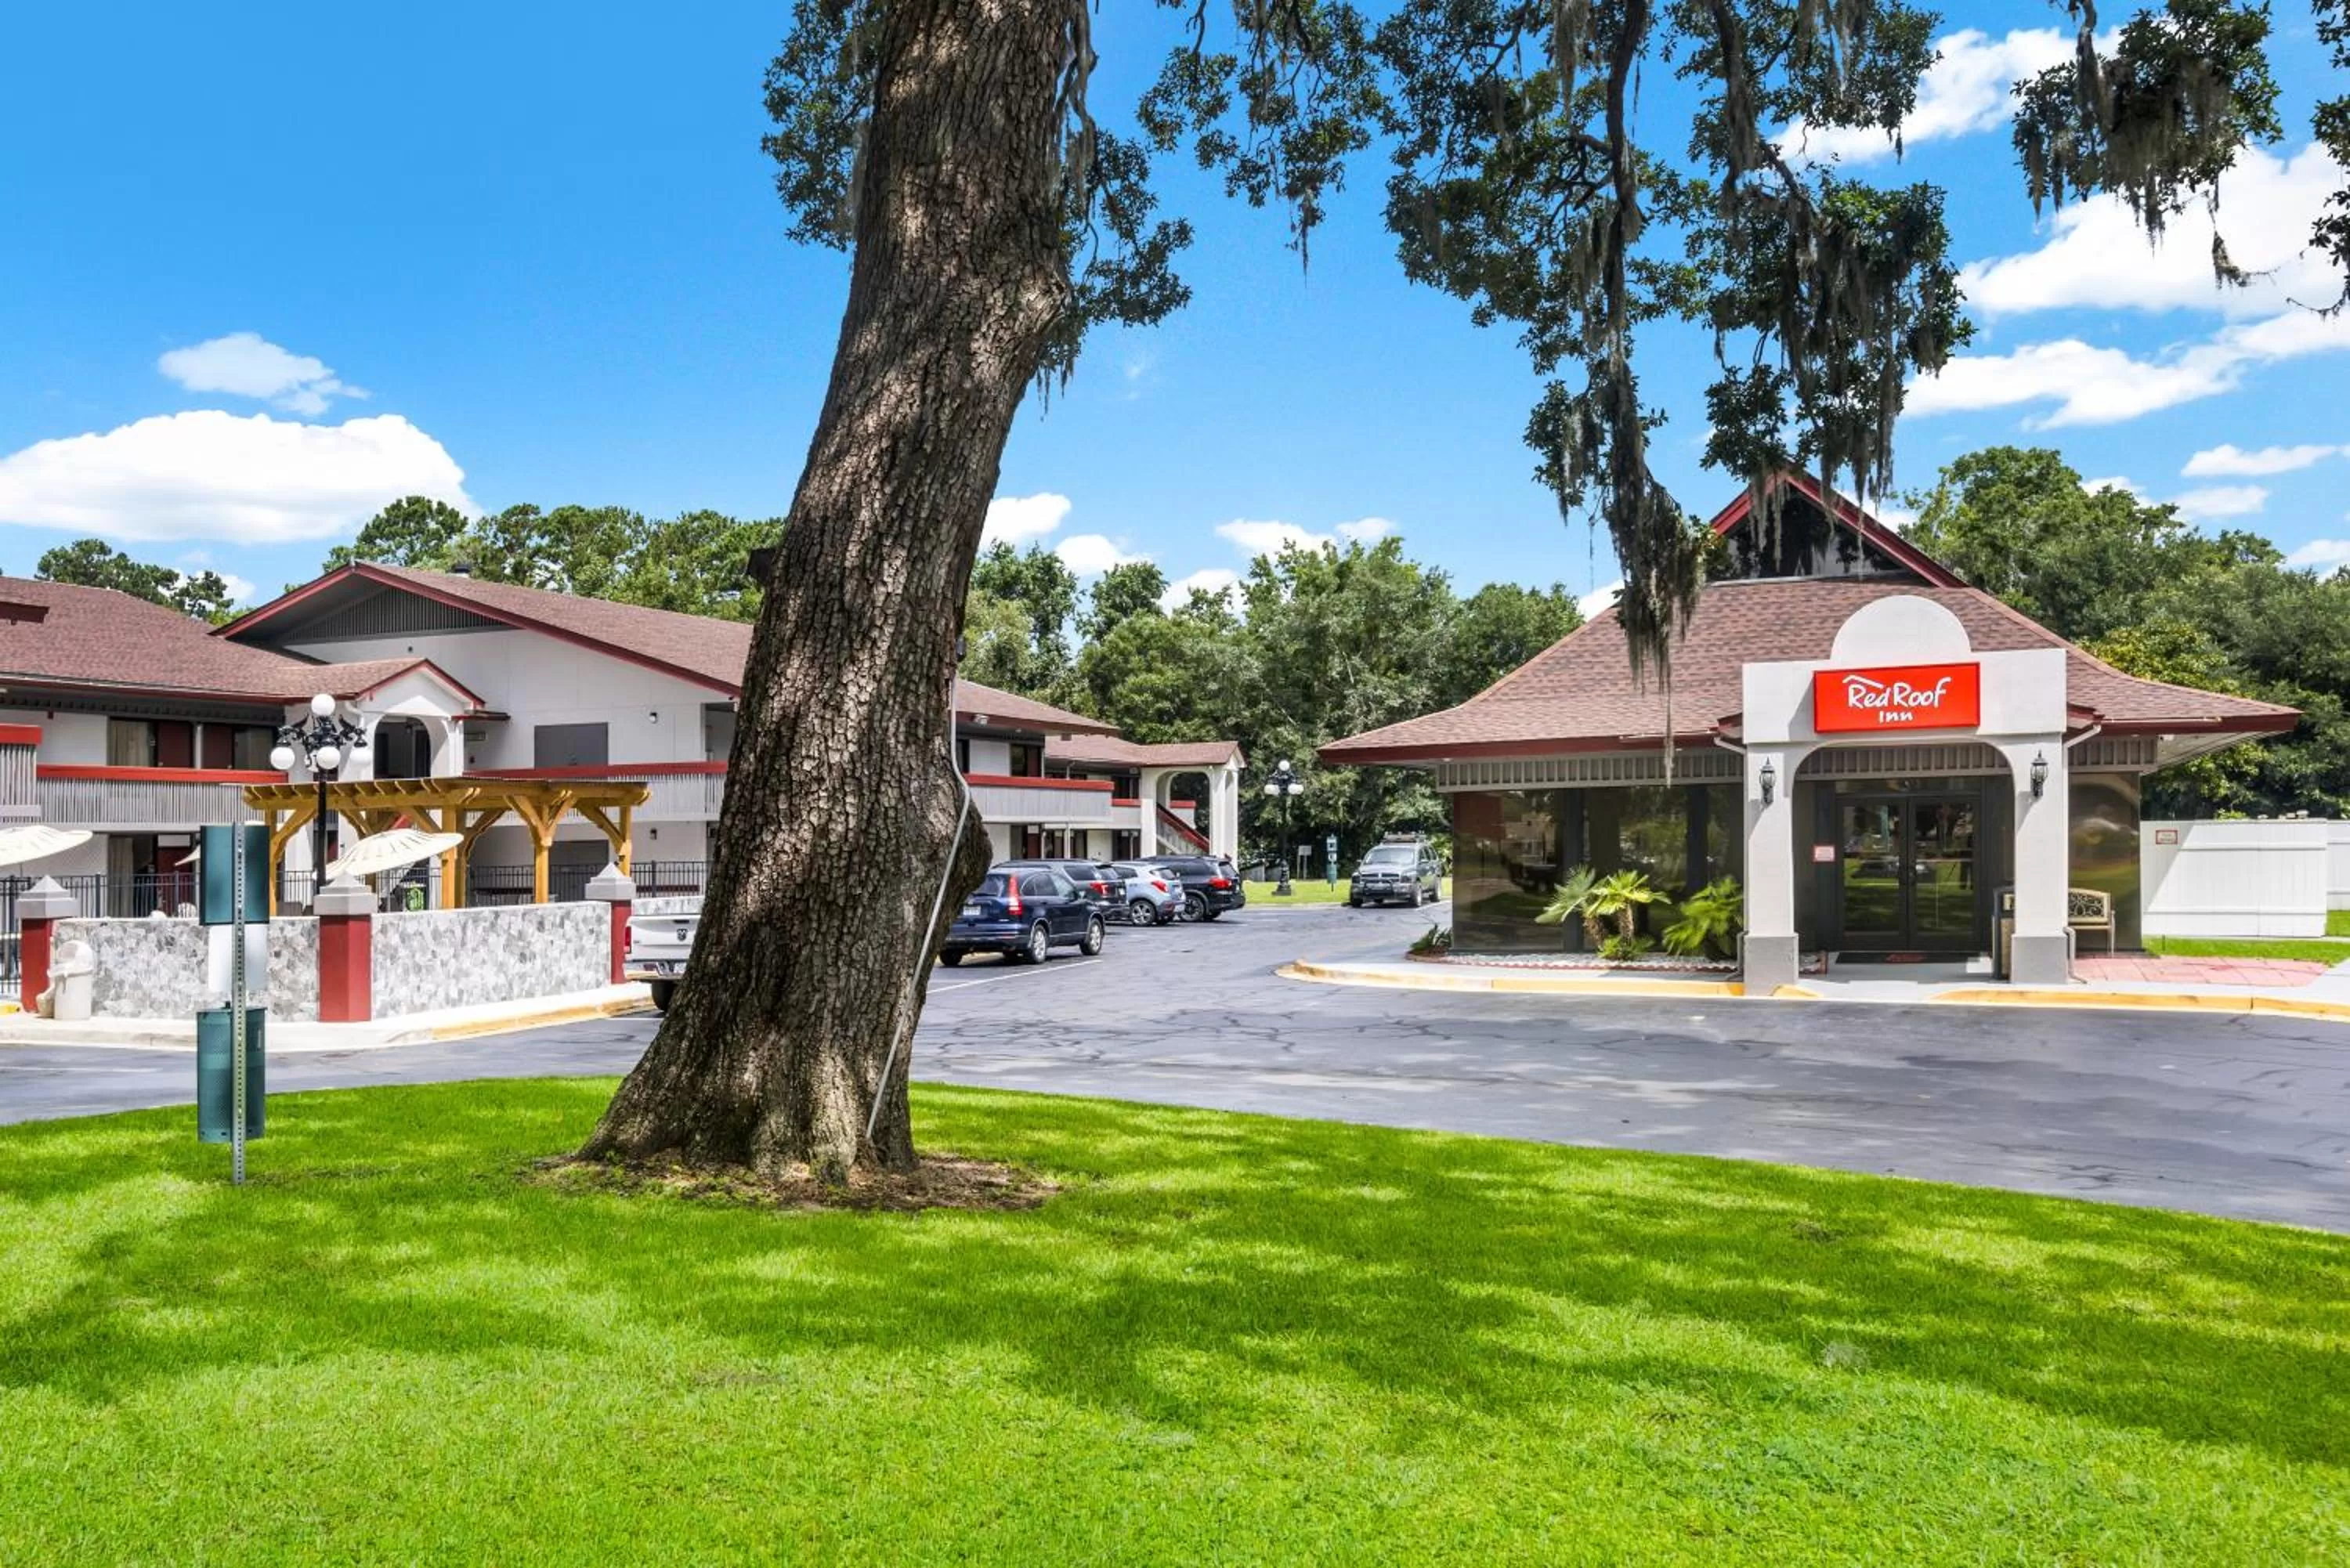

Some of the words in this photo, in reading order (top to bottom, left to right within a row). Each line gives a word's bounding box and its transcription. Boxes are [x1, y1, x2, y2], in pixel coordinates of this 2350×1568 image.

[1848, 684, 1892, 709] Red
[1893, 677, 1952, 708] Roof
[1879, 710, 1914, 723] Inn
